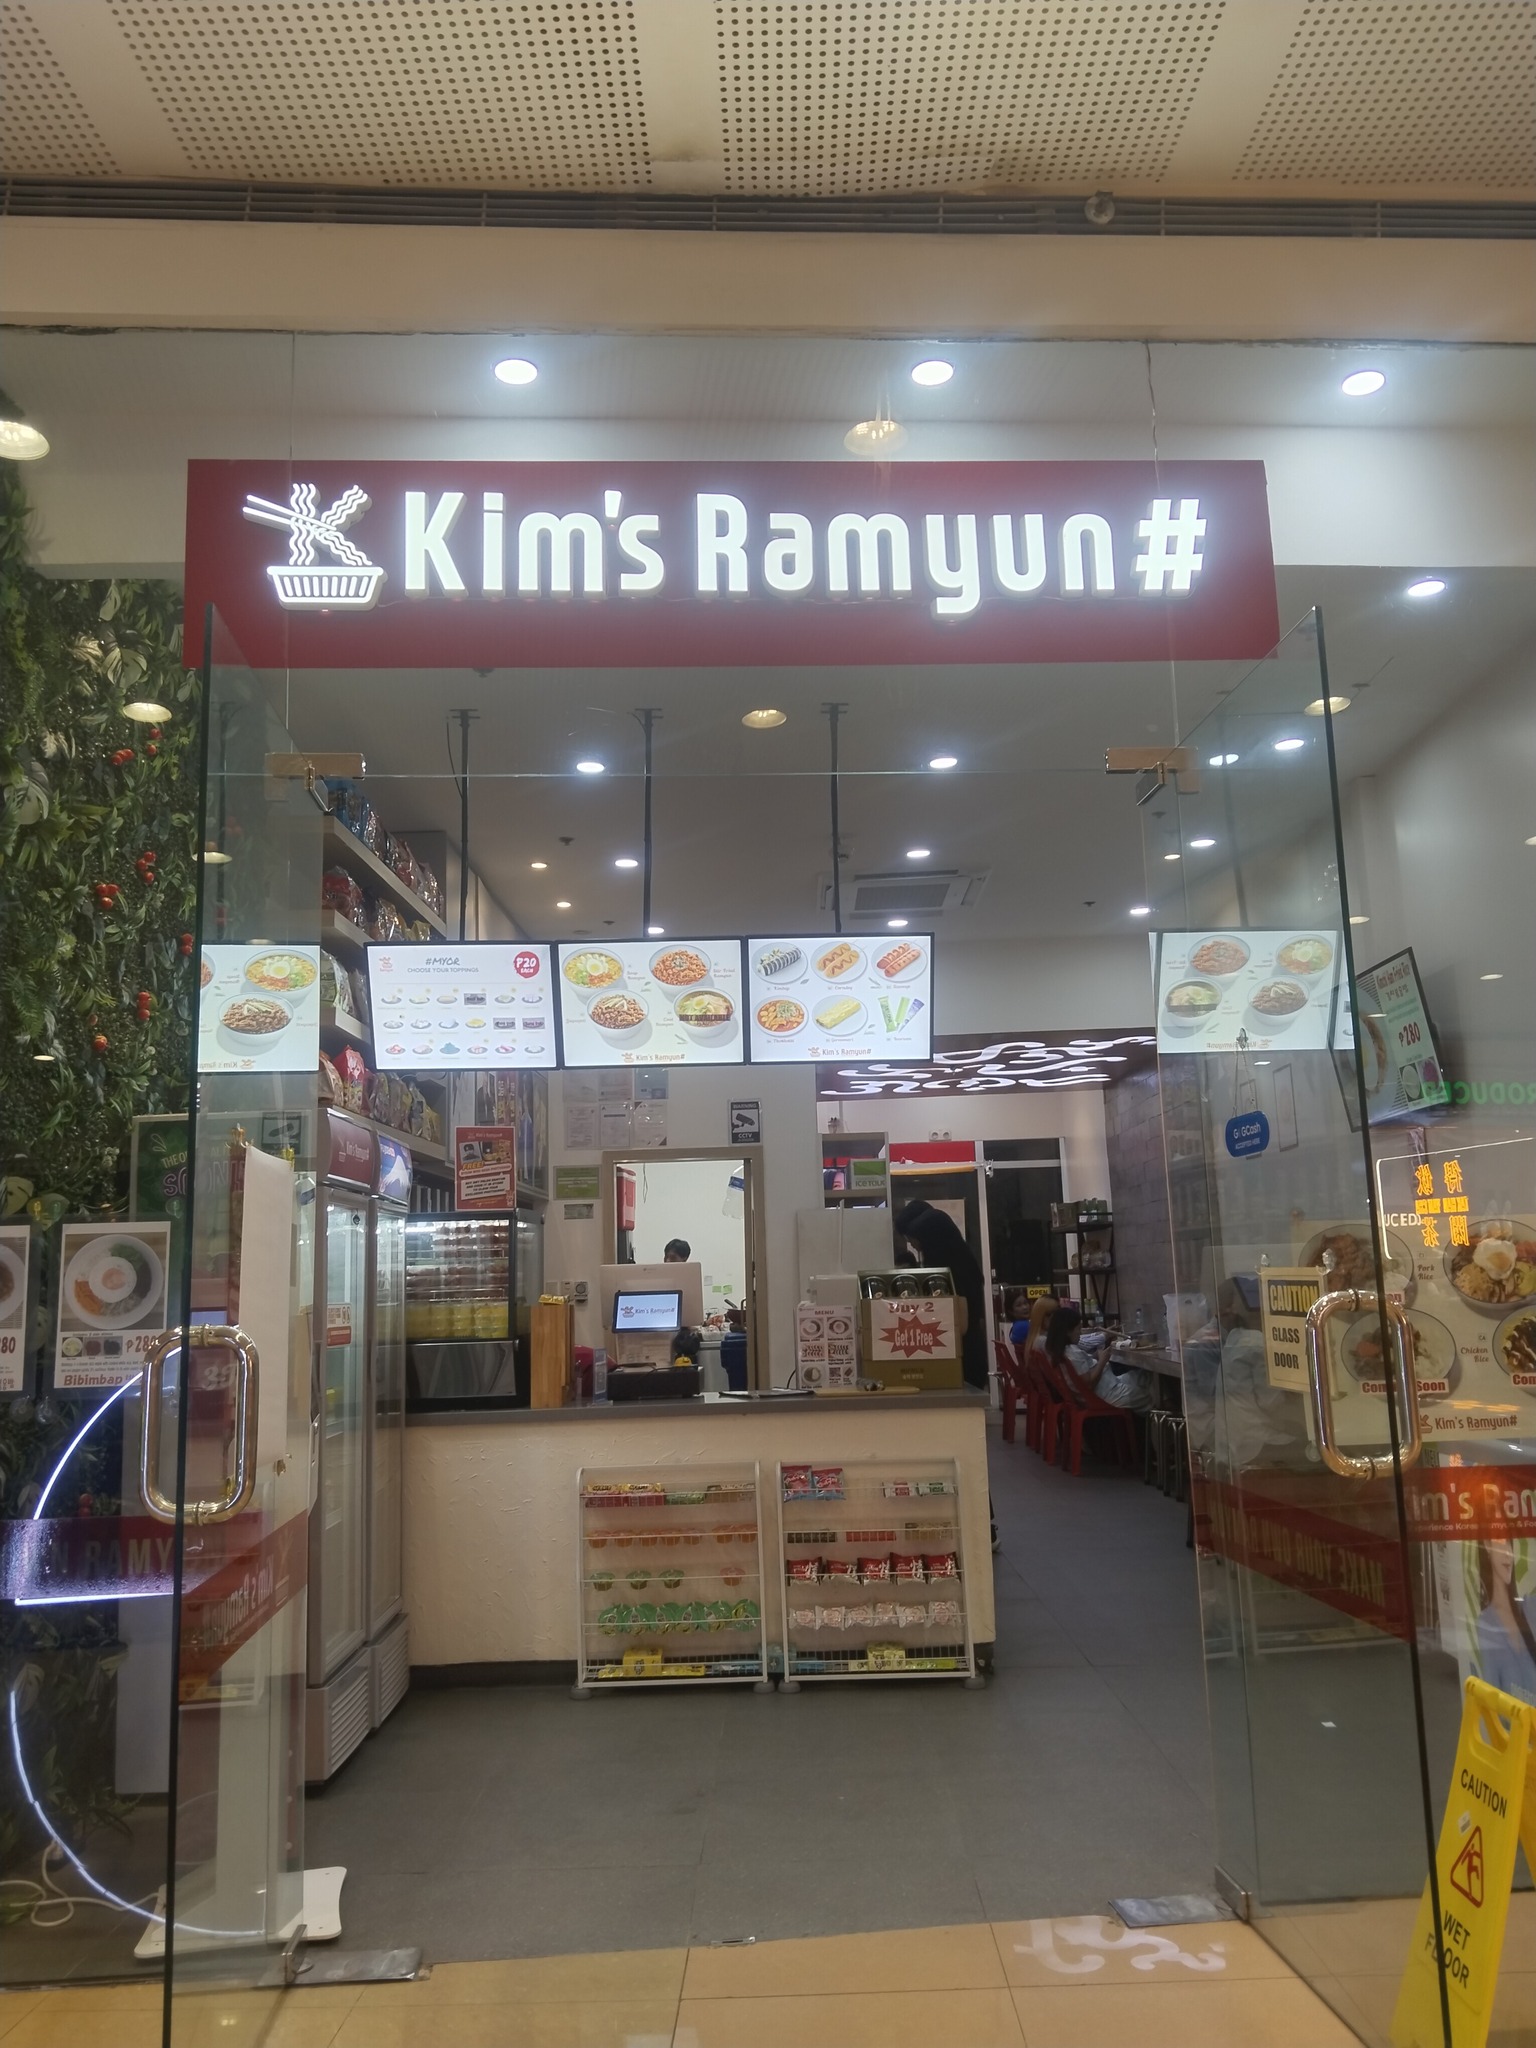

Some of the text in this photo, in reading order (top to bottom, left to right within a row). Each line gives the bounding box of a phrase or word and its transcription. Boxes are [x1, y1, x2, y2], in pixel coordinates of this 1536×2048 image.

[404, 489, 665, 594] Kim's
[425, 957, 461, 966] #MYOR
[822, 1048, 840, 1056] Kim's
[1241, 1122, 1261, 1137] GCash
[161, 1155, 179, 1169] THE
[1417, 1264, 1435, 1272] Pork
[1417, 1272, 1434, 1280] Rice
[1029, 1289, 1048, 1297] OPEN
[1269, 1284, 1318, 1313] CAUTION
[889, 1301, 935, 1314] Buy 2
[894, 1328, 934, 1347] Get 1 Free
[1271, 1326, 1300, 1343] GLASS
[0, 1336, 17, 1354] 80
[1460, 1346, 1488, 1354] Chicken
[1273, 1351, 1300, 1370] DOOR
[1473, 1354, 1489, 1363] Rice
[63, 1374, 123, 1387] Bibimbap
[1435, 1417, 1464, 1431] Kim's
[1406, 1482, 1474, 1521] im's
[1460, 1768, 1508, 1819] CAUTION
[1443, 1909, 1471, 1951] WET
